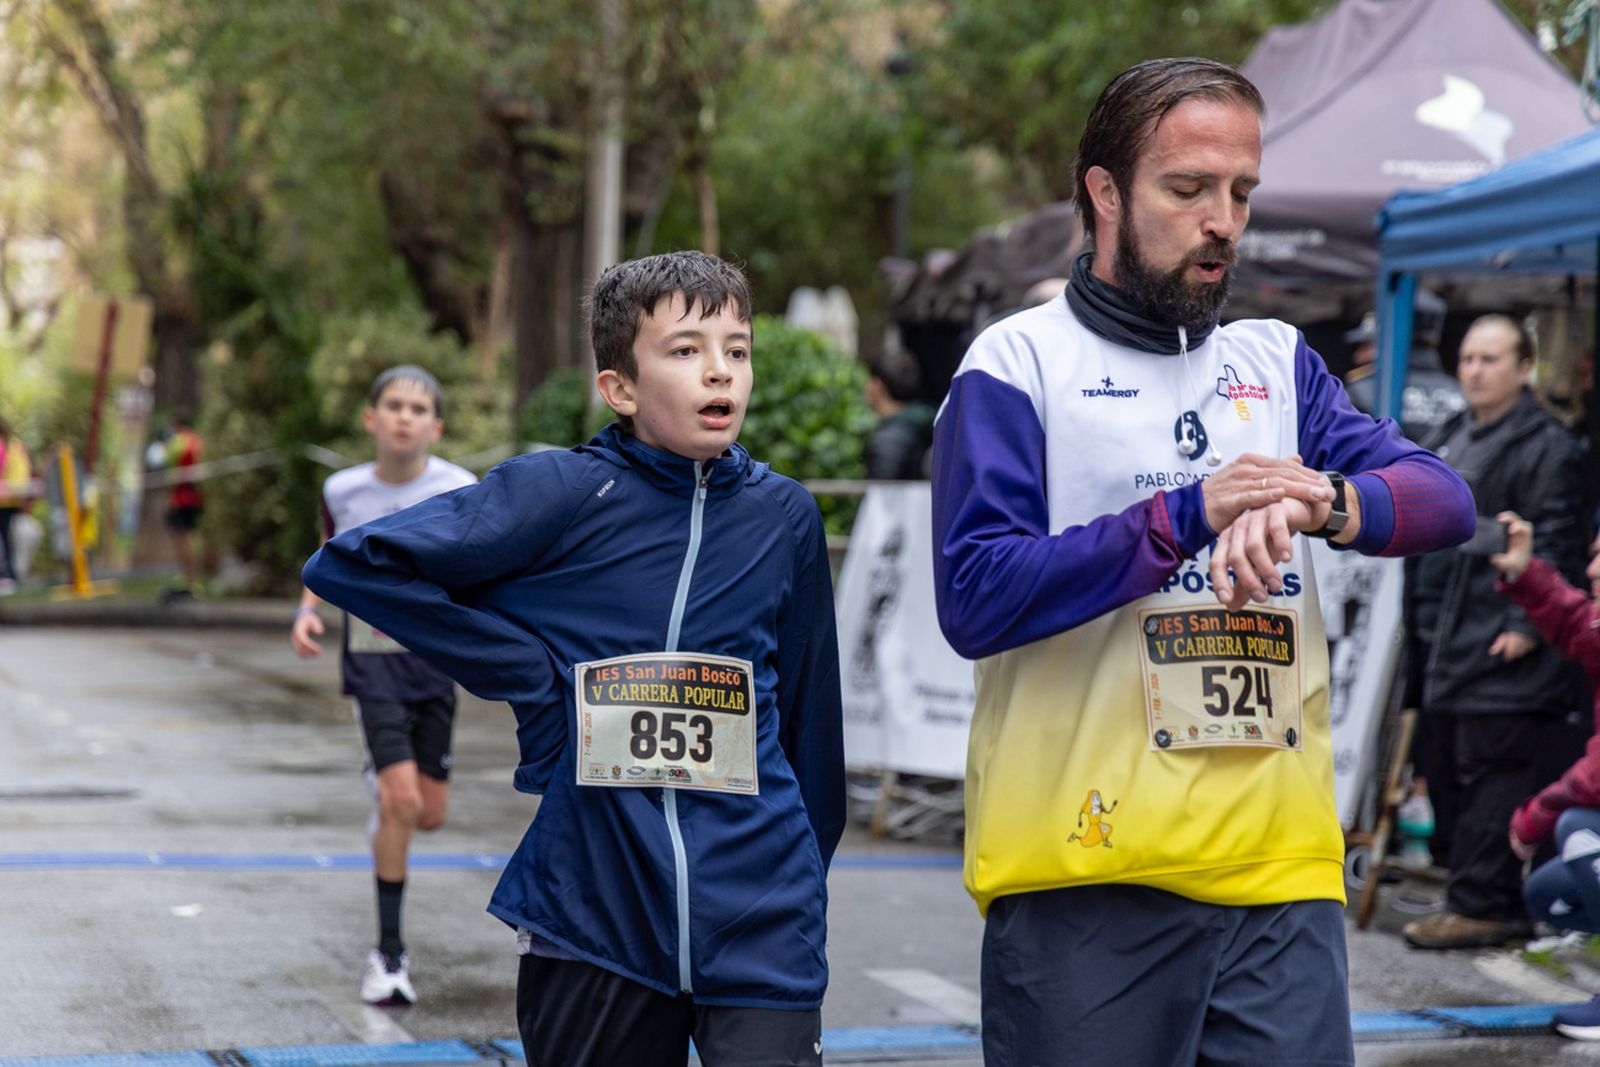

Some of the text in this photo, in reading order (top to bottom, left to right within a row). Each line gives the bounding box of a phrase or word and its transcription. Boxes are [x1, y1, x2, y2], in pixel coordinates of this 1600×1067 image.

[1135, 472, 1185, 489] PABLO
[1158, 618, 1184, 636] IES
[1189, 614, 1221, 632] San
[1225, 613, 1255, 631] Juan
[1155, 636, 1290, 661] V CARRERA POPULAR
[596, 664, 741, 686] IES San Juan Bosco
[592, 683, 745, 710] V CARRERA POPULAR
[1202, 665, 1273, 718] 524
[630, 710, 714, 763] 853
